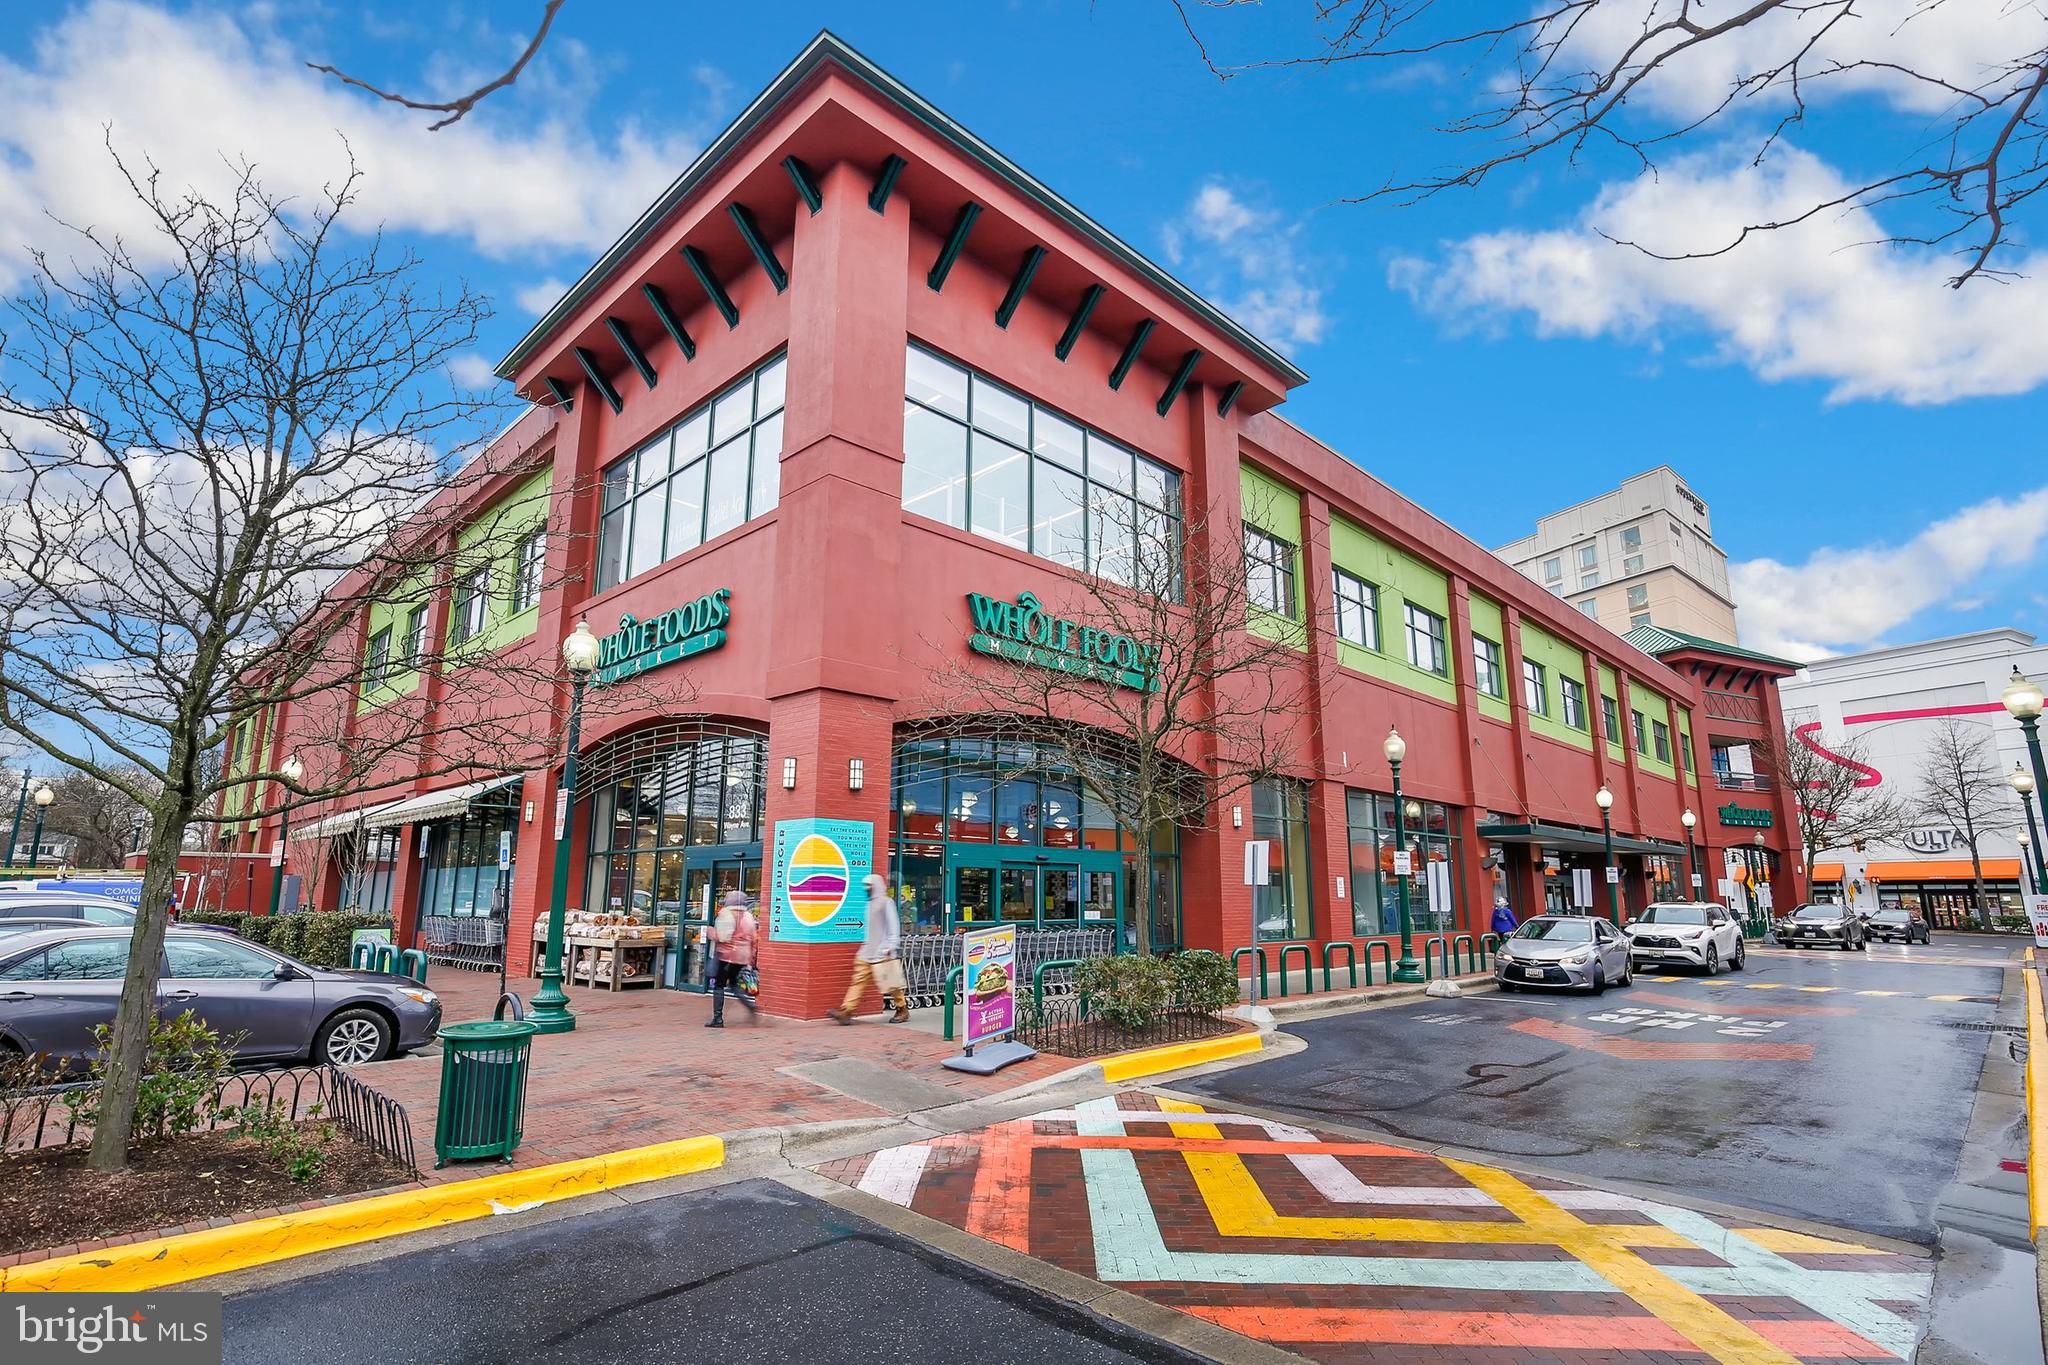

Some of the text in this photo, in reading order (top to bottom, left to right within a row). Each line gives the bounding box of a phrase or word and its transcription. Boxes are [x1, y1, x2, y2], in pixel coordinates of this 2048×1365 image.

[653, 588, 731, 649] FOODS
[966, 591, 1077, 655] WHOLE
[729, 804, 746, 819] 833
[1911, 830, 1968, 846] ULTA
[774, 829, 785, 933] PLNT BURGER
